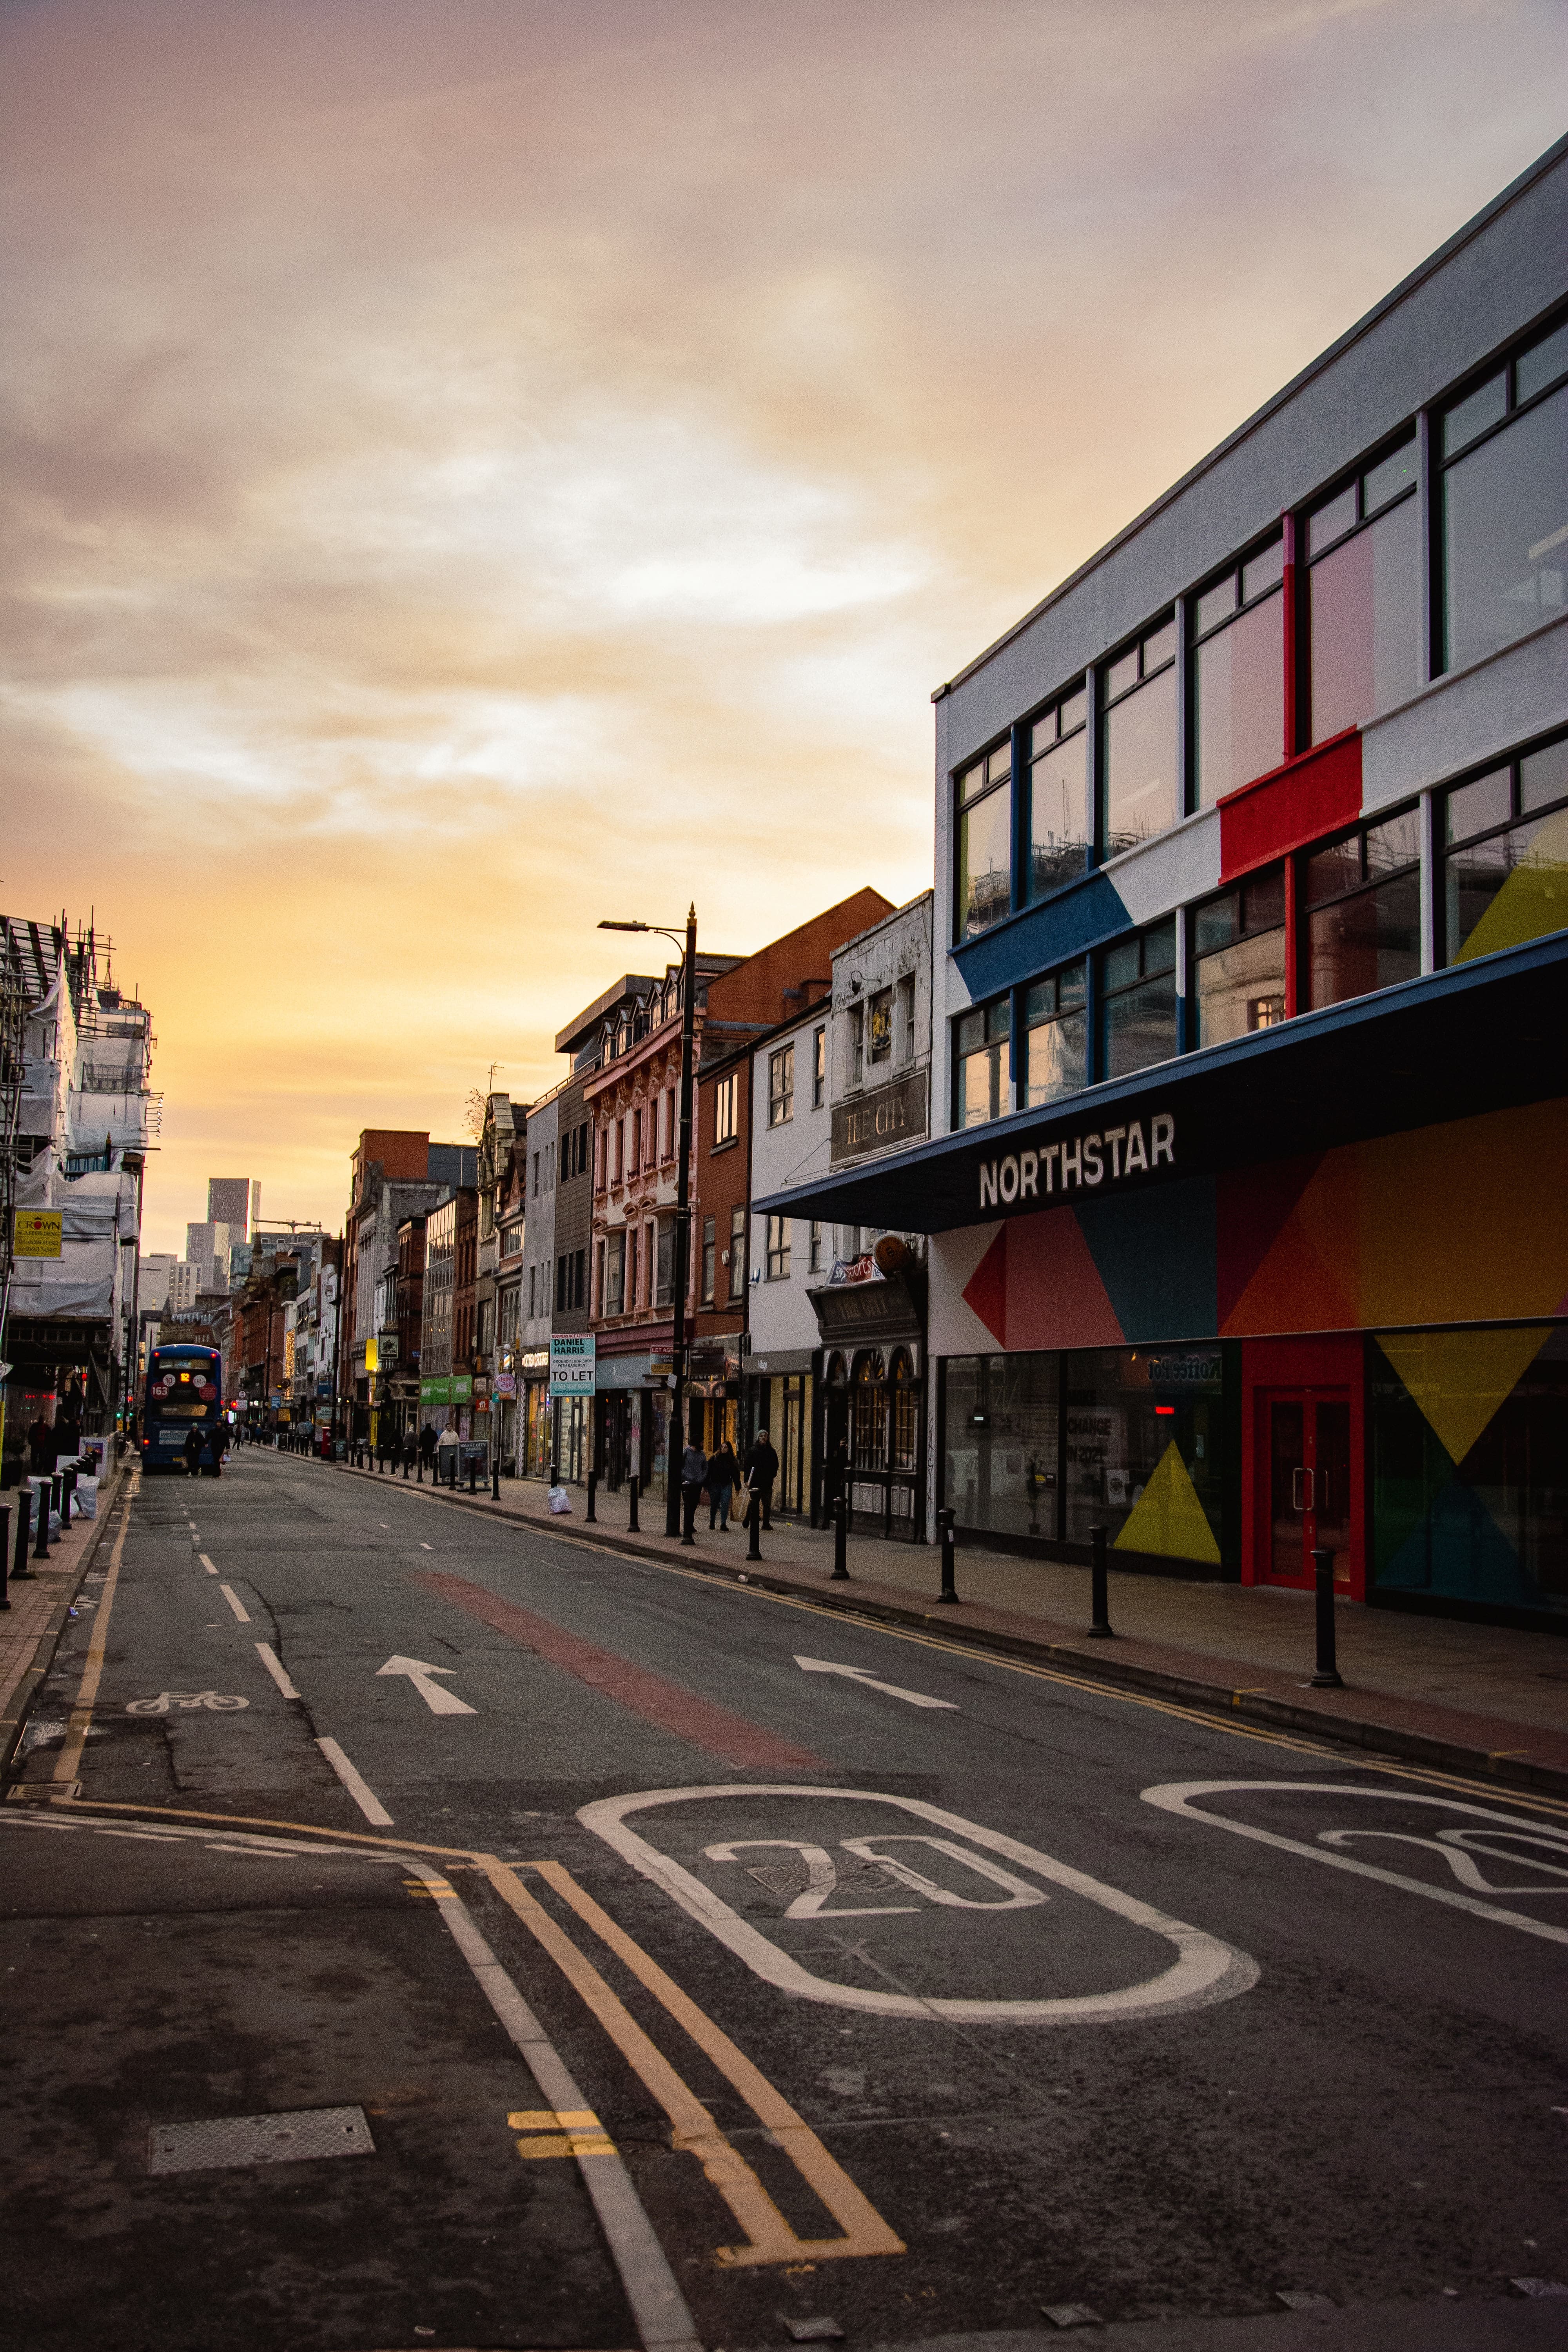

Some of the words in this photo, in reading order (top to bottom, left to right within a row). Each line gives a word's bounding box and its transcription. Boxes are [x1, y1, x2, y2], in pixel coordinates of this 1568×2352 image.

[847, 1110, 869, 1144] THE
[876, 1097, 905, 1135] CITY
[980, 1112, 1175, 1209] NORTHSTAR
[18, 1220, 60, 1230] CROWN
[834, 1265, 846, 1282] sky
[846, 1259, 871, 1281] sports
[758, 1360, 768, 1371] Village
[552, 1371, 568, 1381] TO
[572, 1371, 593, 1381] LET
[152, 1386, 168, 1396] 163
[1067, 1417, 1111, 1436] CHANGE
[1067, 1446, 1077, 1462] IN
[702, 1835, 1051, 1919] 20
